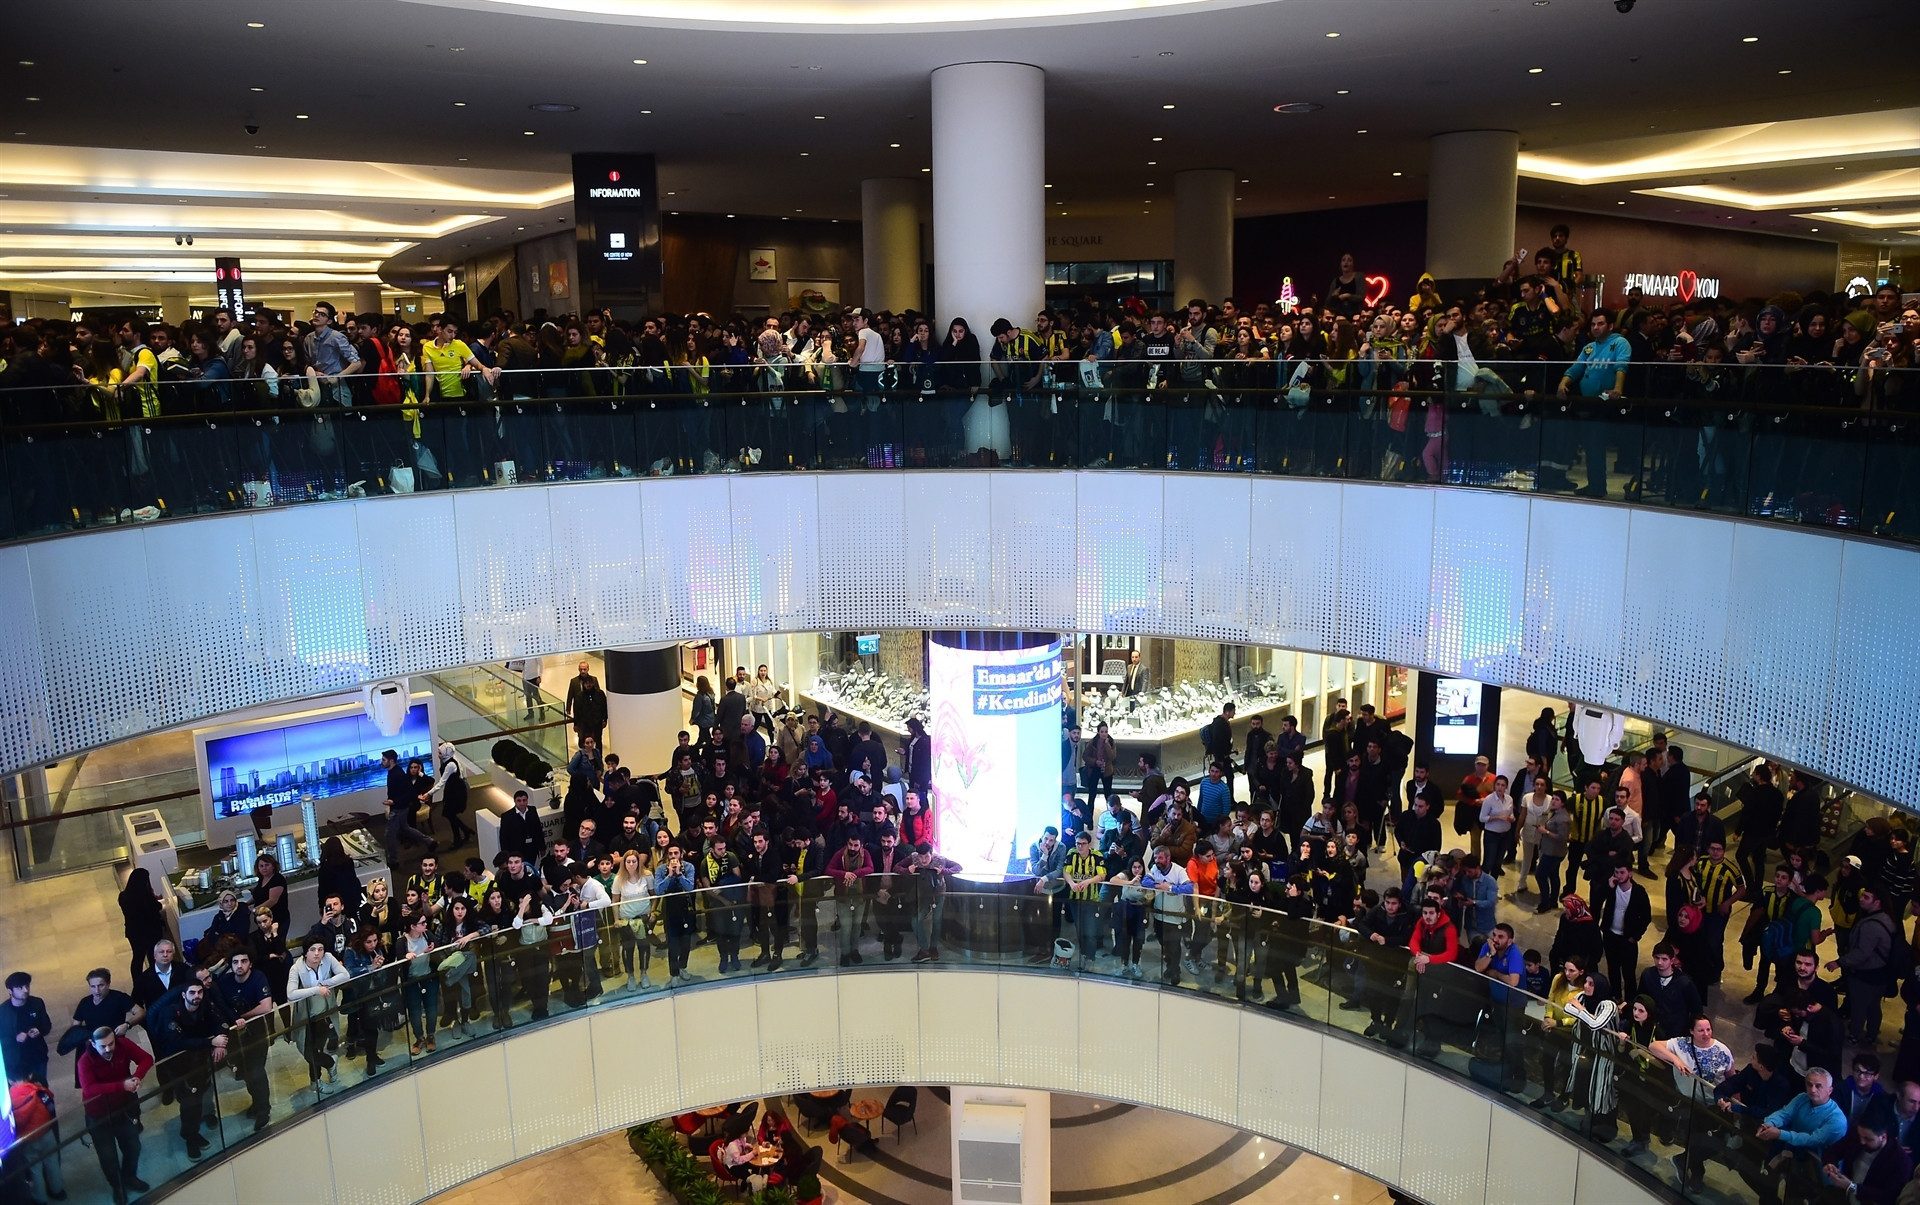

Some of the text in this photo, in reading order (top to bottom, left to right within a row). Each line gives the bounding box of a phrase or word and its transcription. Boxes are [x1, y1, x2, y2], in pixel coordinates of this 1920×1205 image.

[590, 188, 641, 198] INFORMATION
[1061, 235, 1103, 247] SQUARE
[1623, 272, 1720, 299] #EMAAR YOU
[232, 288, 245, 323] INFORM
[1149, 347, 1167, 355] BE REAL
[976, 665, 1050, 686] Emaar'da
[230, 788, 299, 807] Dubai Creek
[231, 795, 292, 813] HARBOUR
